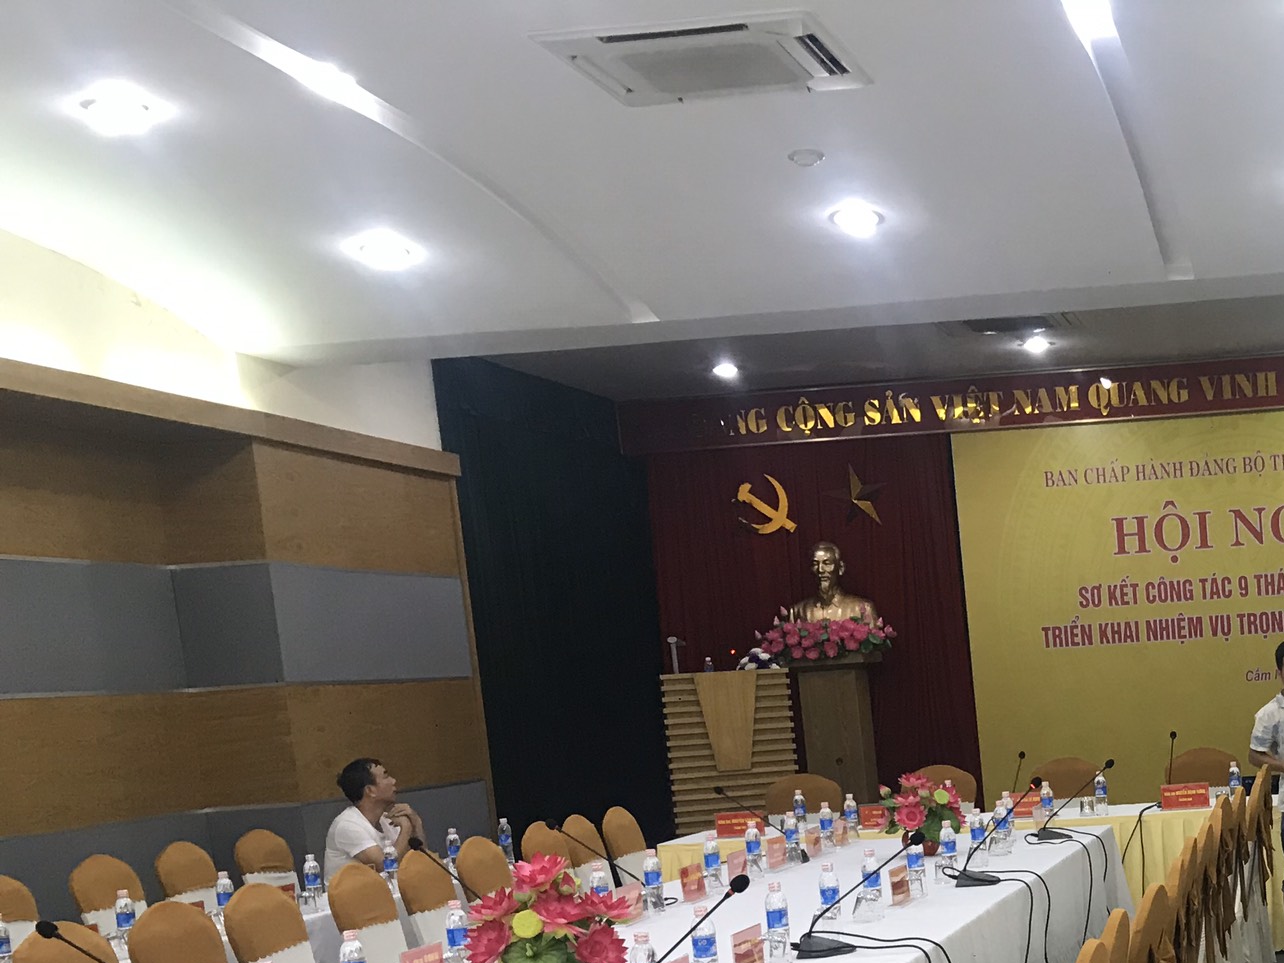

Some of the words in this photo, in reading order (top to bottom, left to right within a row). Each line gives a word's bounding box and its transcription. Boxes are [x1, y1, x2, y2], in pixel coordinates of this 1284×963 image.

[775, 396, 856, 436] CỘNG
[863, 390, 922, 426] SẢN
[929, 385, 1004, 424] VIỆT
[1012, 384, 1080, 417] NAM
[1087, 376, 1190, 416] QUANG
[1199, 370, 1279, 401] VINH
[1043, 468, 1079, 488] BAN
[1083, 458, 1131, 485] CHẤP
[1135, 457, 1184, 482] HÀNH
[1188, 452, 1238, 478] ĐẢNG
[1242, 450, 1266, 478] BỘ
[1110, 500, 1214, 564] HỘI
[1078, 583, 1103, 609] SƠ
[1106, 575, 1140, 608] KẾT
[1144, 576, 1195, 604] CÔNG
[1198, 572, 1233, 601] TÁC
[1237, 575, 1249, 598] 9
[1041, 615, 1094, 649] TRIỂN
[1097, 620, 1141, 645] KHAI
[1145, 612, 1204, 645] NHIỆM
[1208, 613, 1232, 642] VỤ
[1245, 667, 1272, 682] Cẩm
